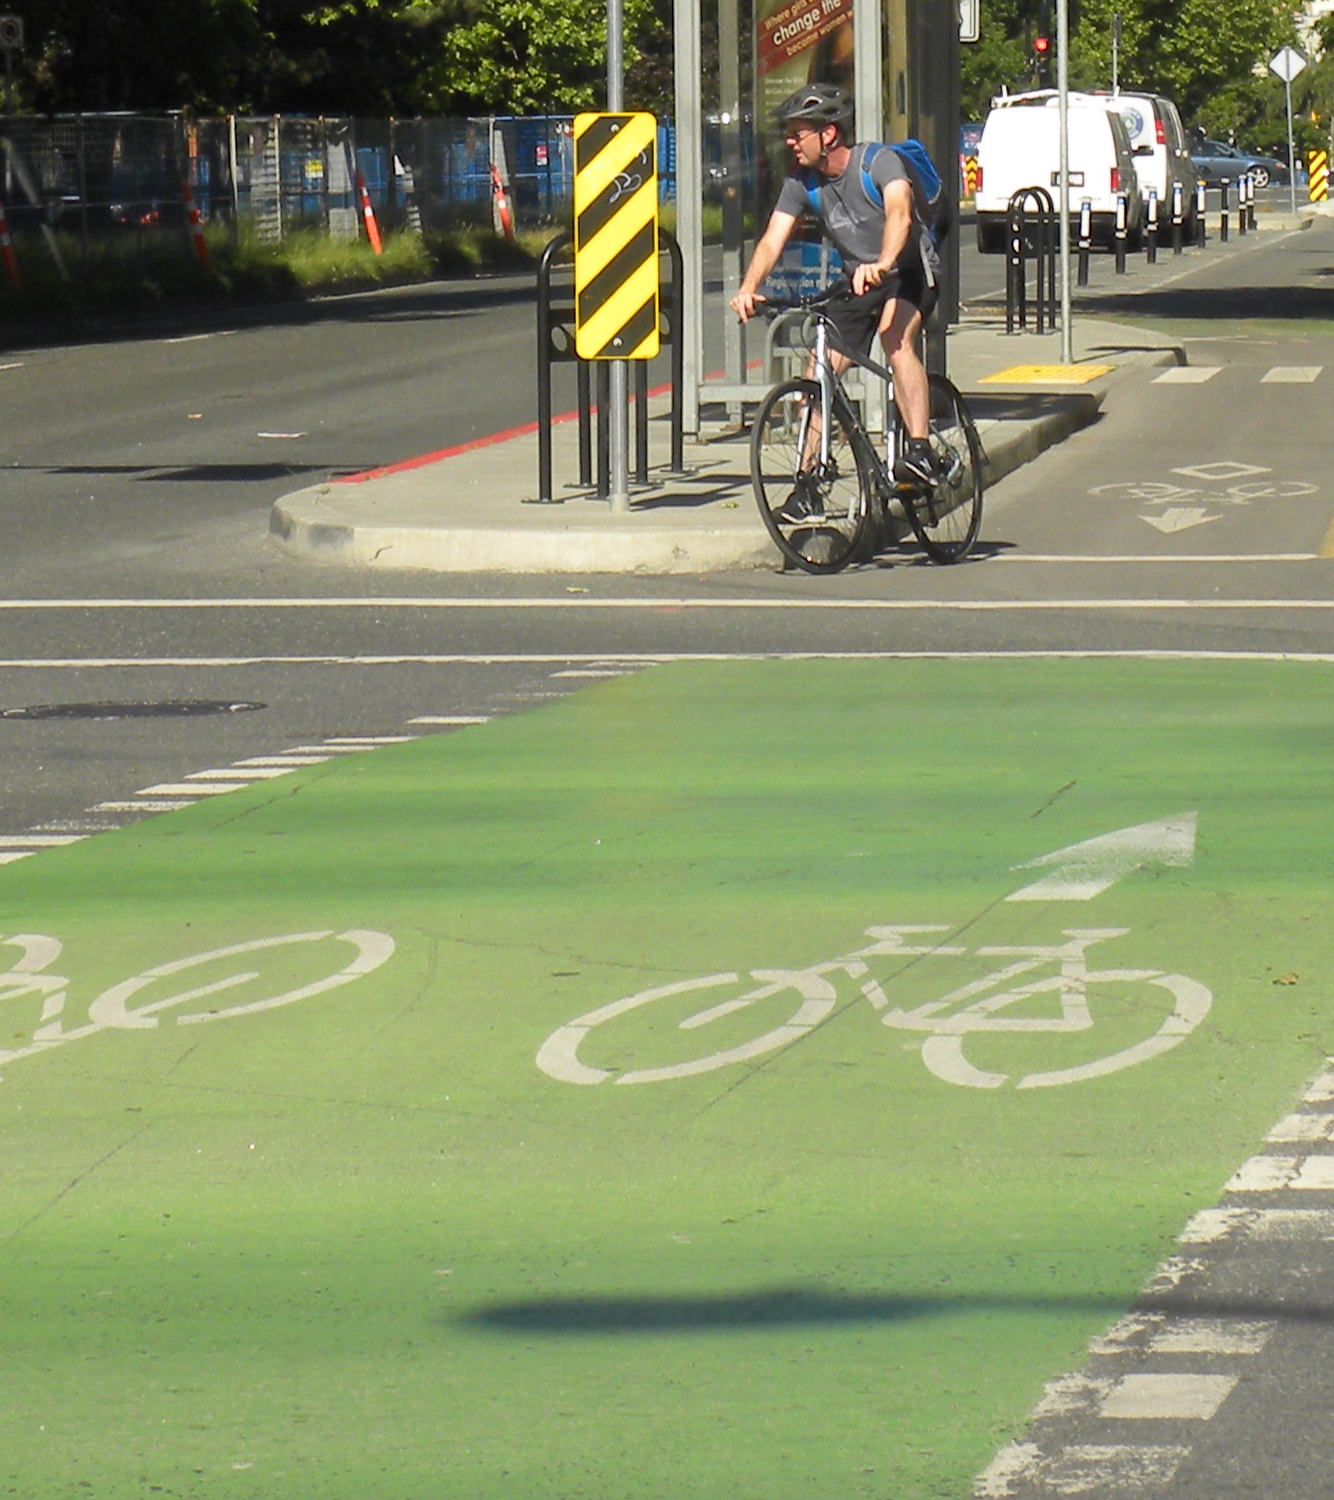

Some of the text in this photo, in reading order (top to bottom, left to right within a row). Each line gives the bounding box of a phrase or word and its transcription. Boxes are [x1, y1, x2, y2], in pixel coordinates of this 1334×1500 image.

[763, 9, 790, 30] Where
[772, 8, 821, 46] change
[785, 13, 847, 57] become women
